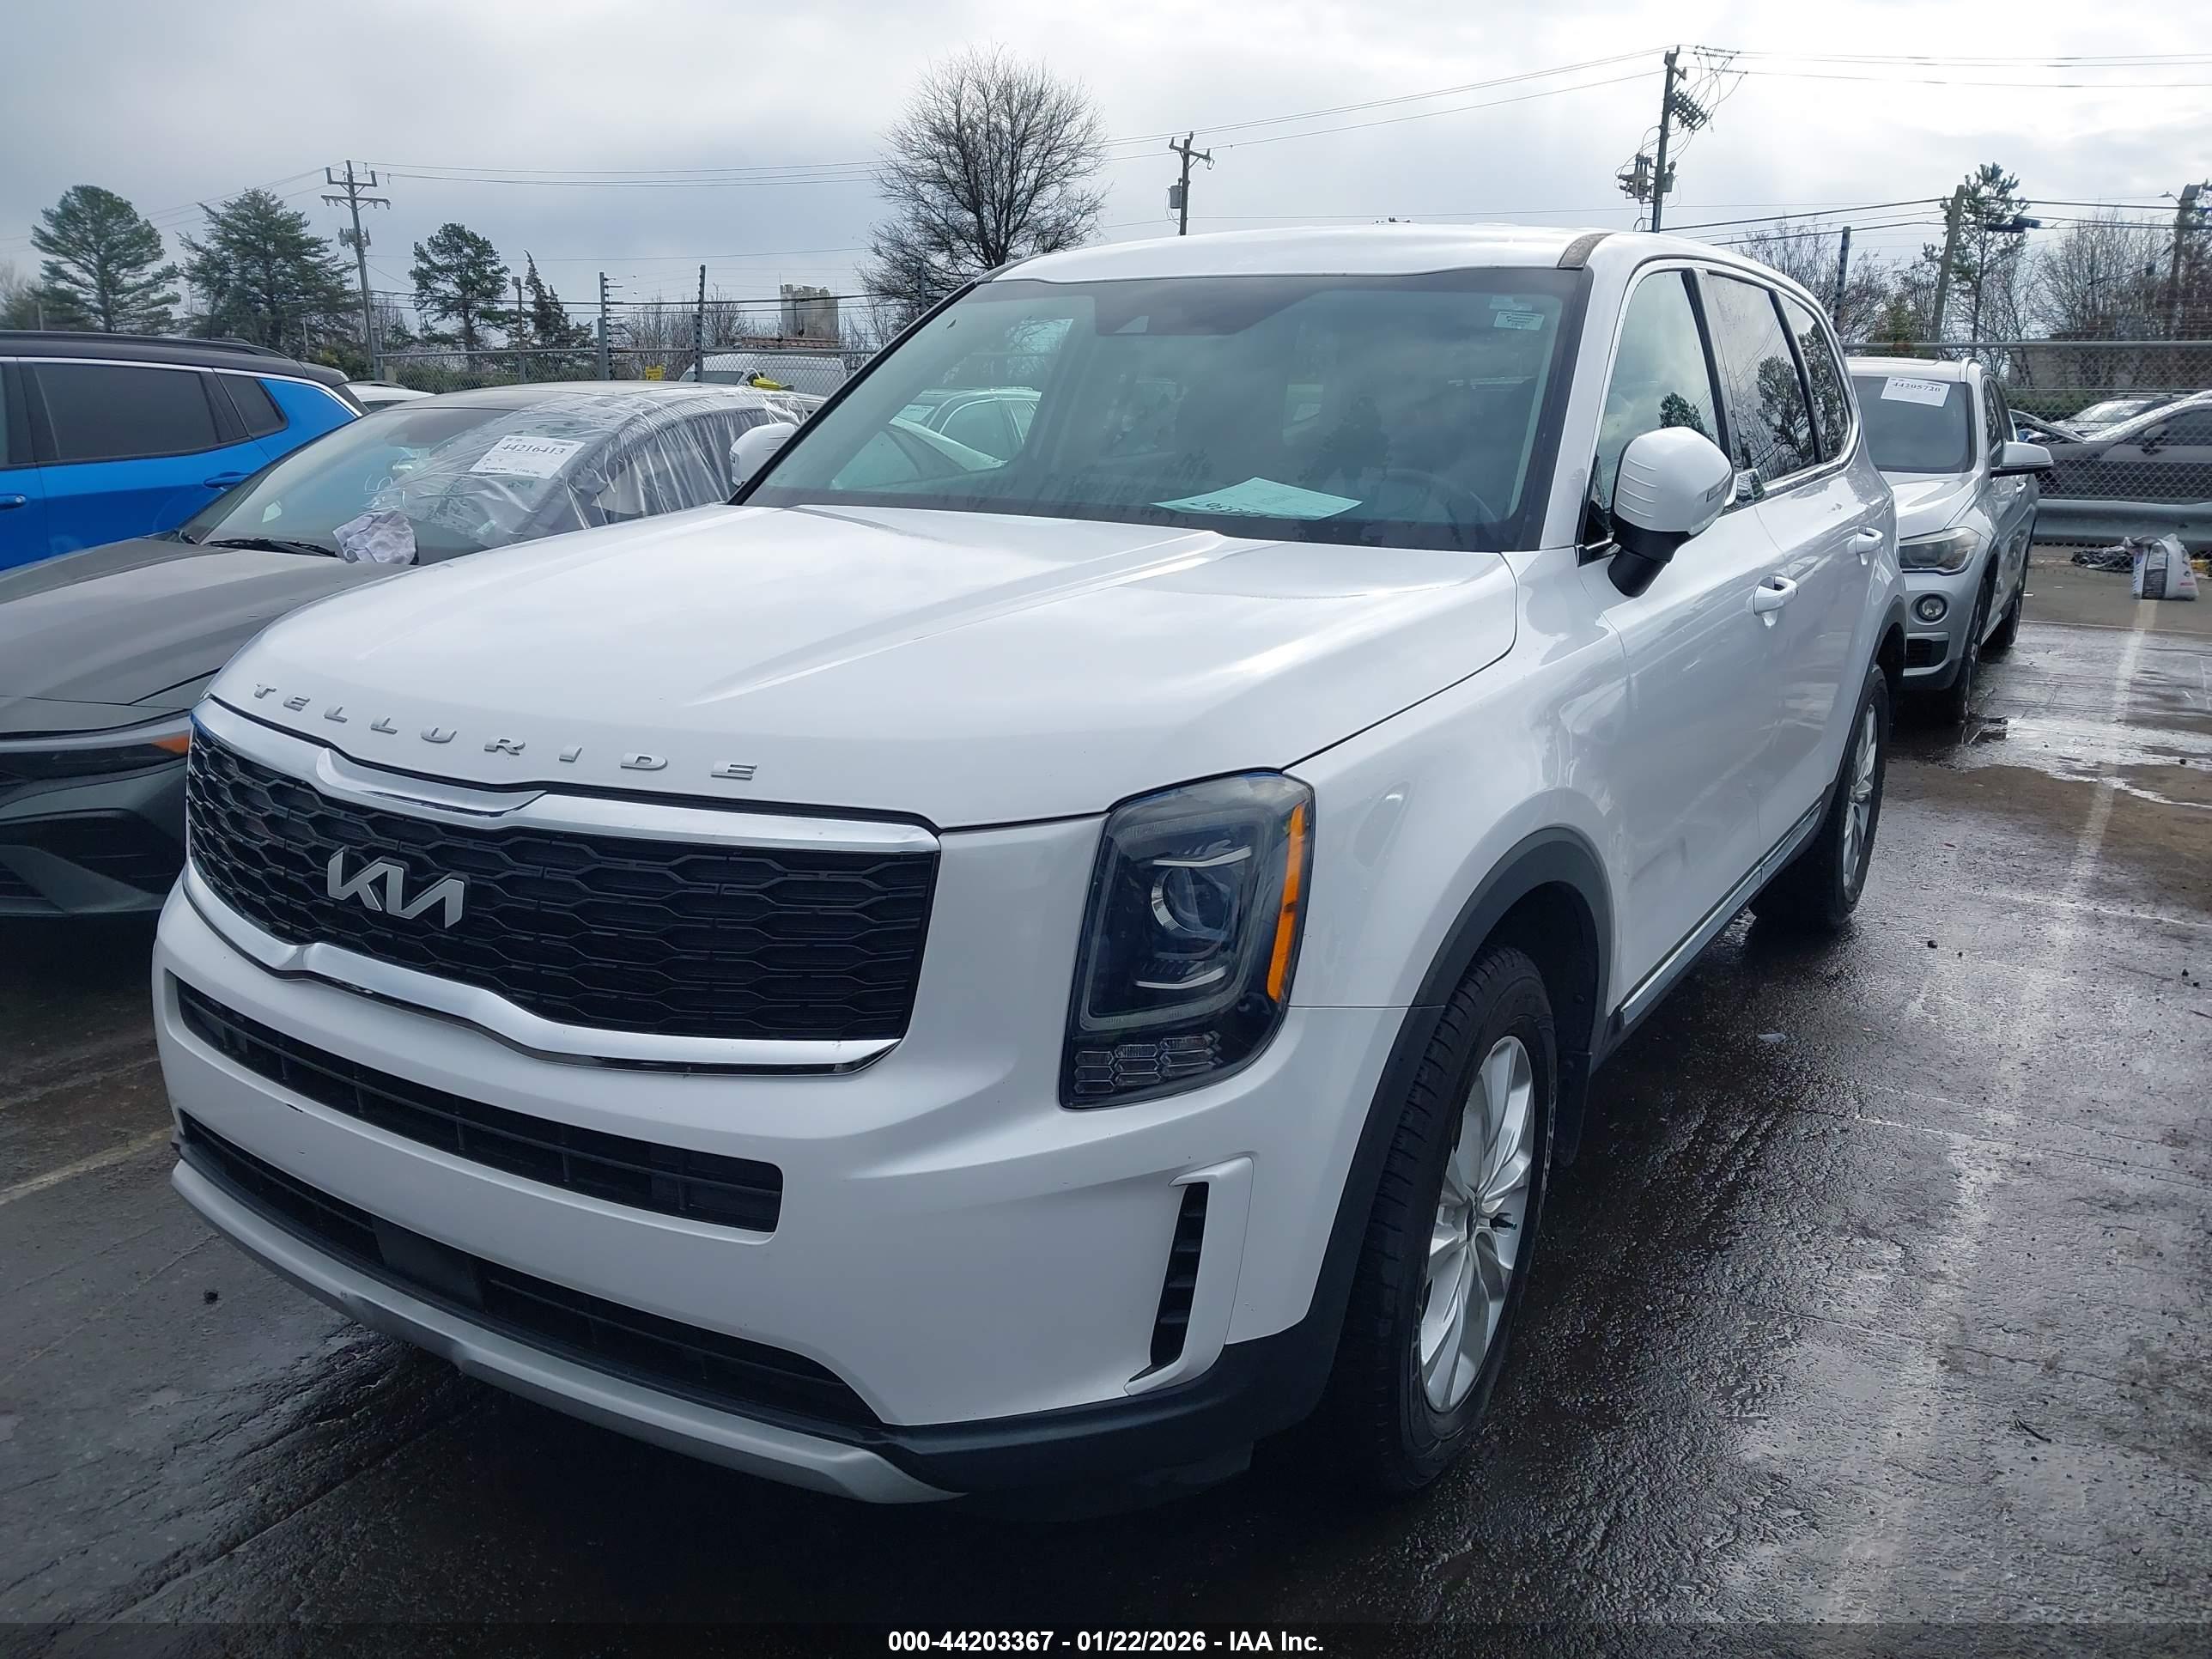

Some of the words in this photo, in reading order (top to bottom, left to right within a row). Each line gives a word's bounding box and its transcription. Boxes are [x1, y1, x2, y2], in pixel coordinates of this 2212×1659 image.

[501, 443, 566, 455] 44216413
[252, 681, 758, 781] TELLURIDE
[326, 850, 465, 929] KIA
